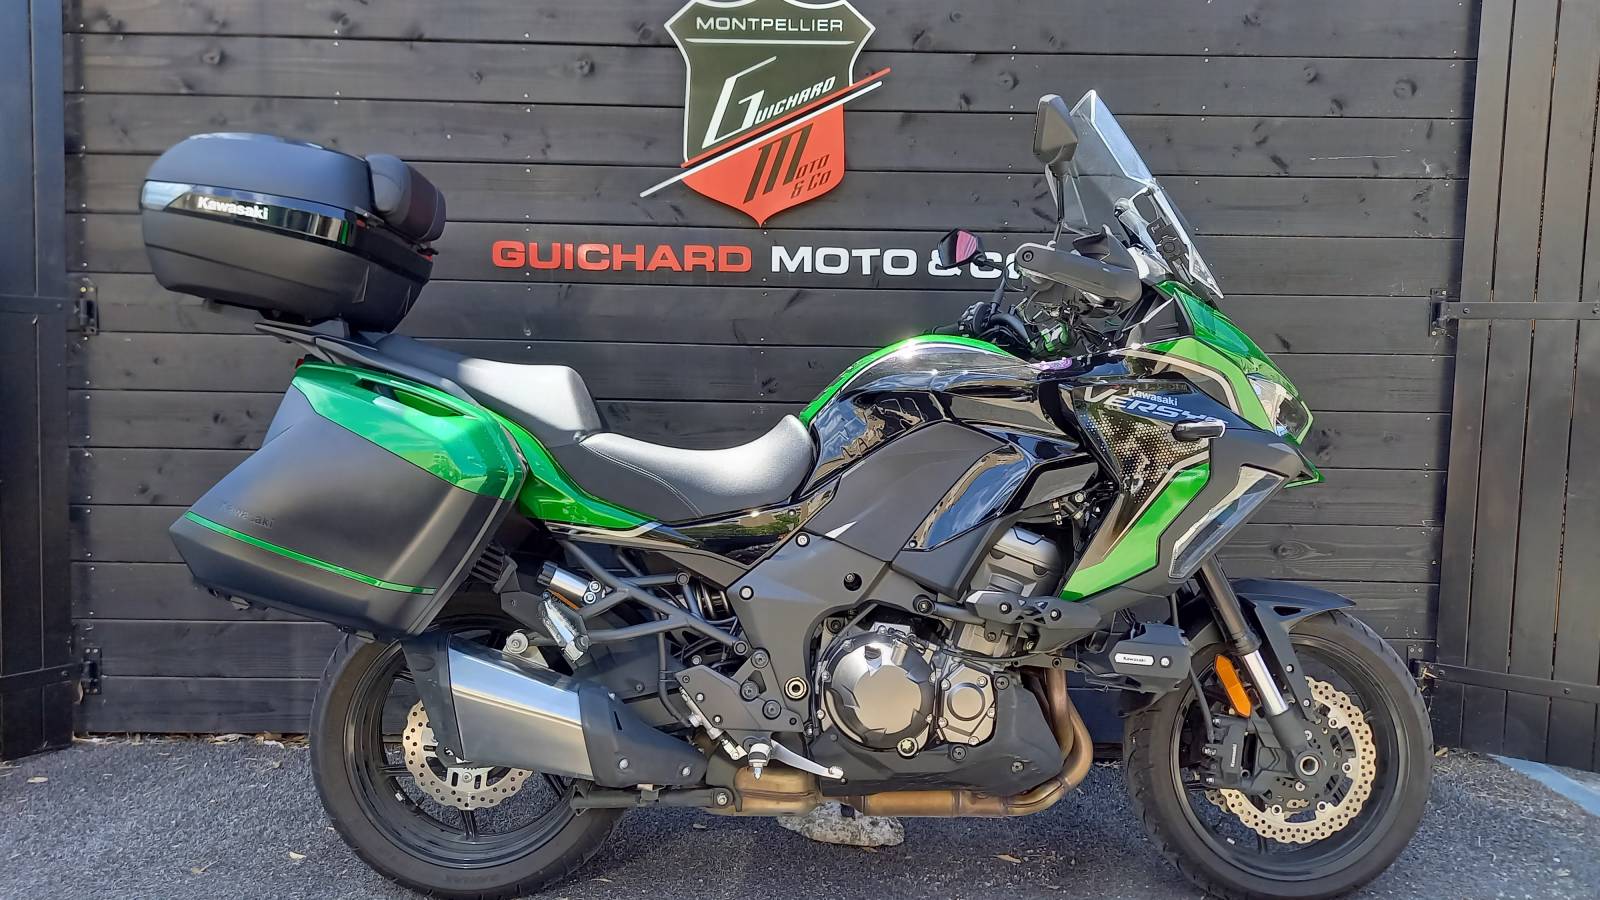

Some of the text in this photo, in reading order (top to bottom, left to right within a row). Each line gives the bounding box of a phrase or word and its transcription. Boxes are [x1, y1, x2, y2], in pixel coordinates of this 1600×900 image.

[696, 16, 843, 33] MONTPELLIER
[701, 55, 836, 150] GUICHARD
[197, 196, 268, 220] Kawasaki
[491, 240, 752, 274] GUICHARD
[770, 245, 919, 278] MOTO
[1128, 386, 1178, 406] Kawasaki
